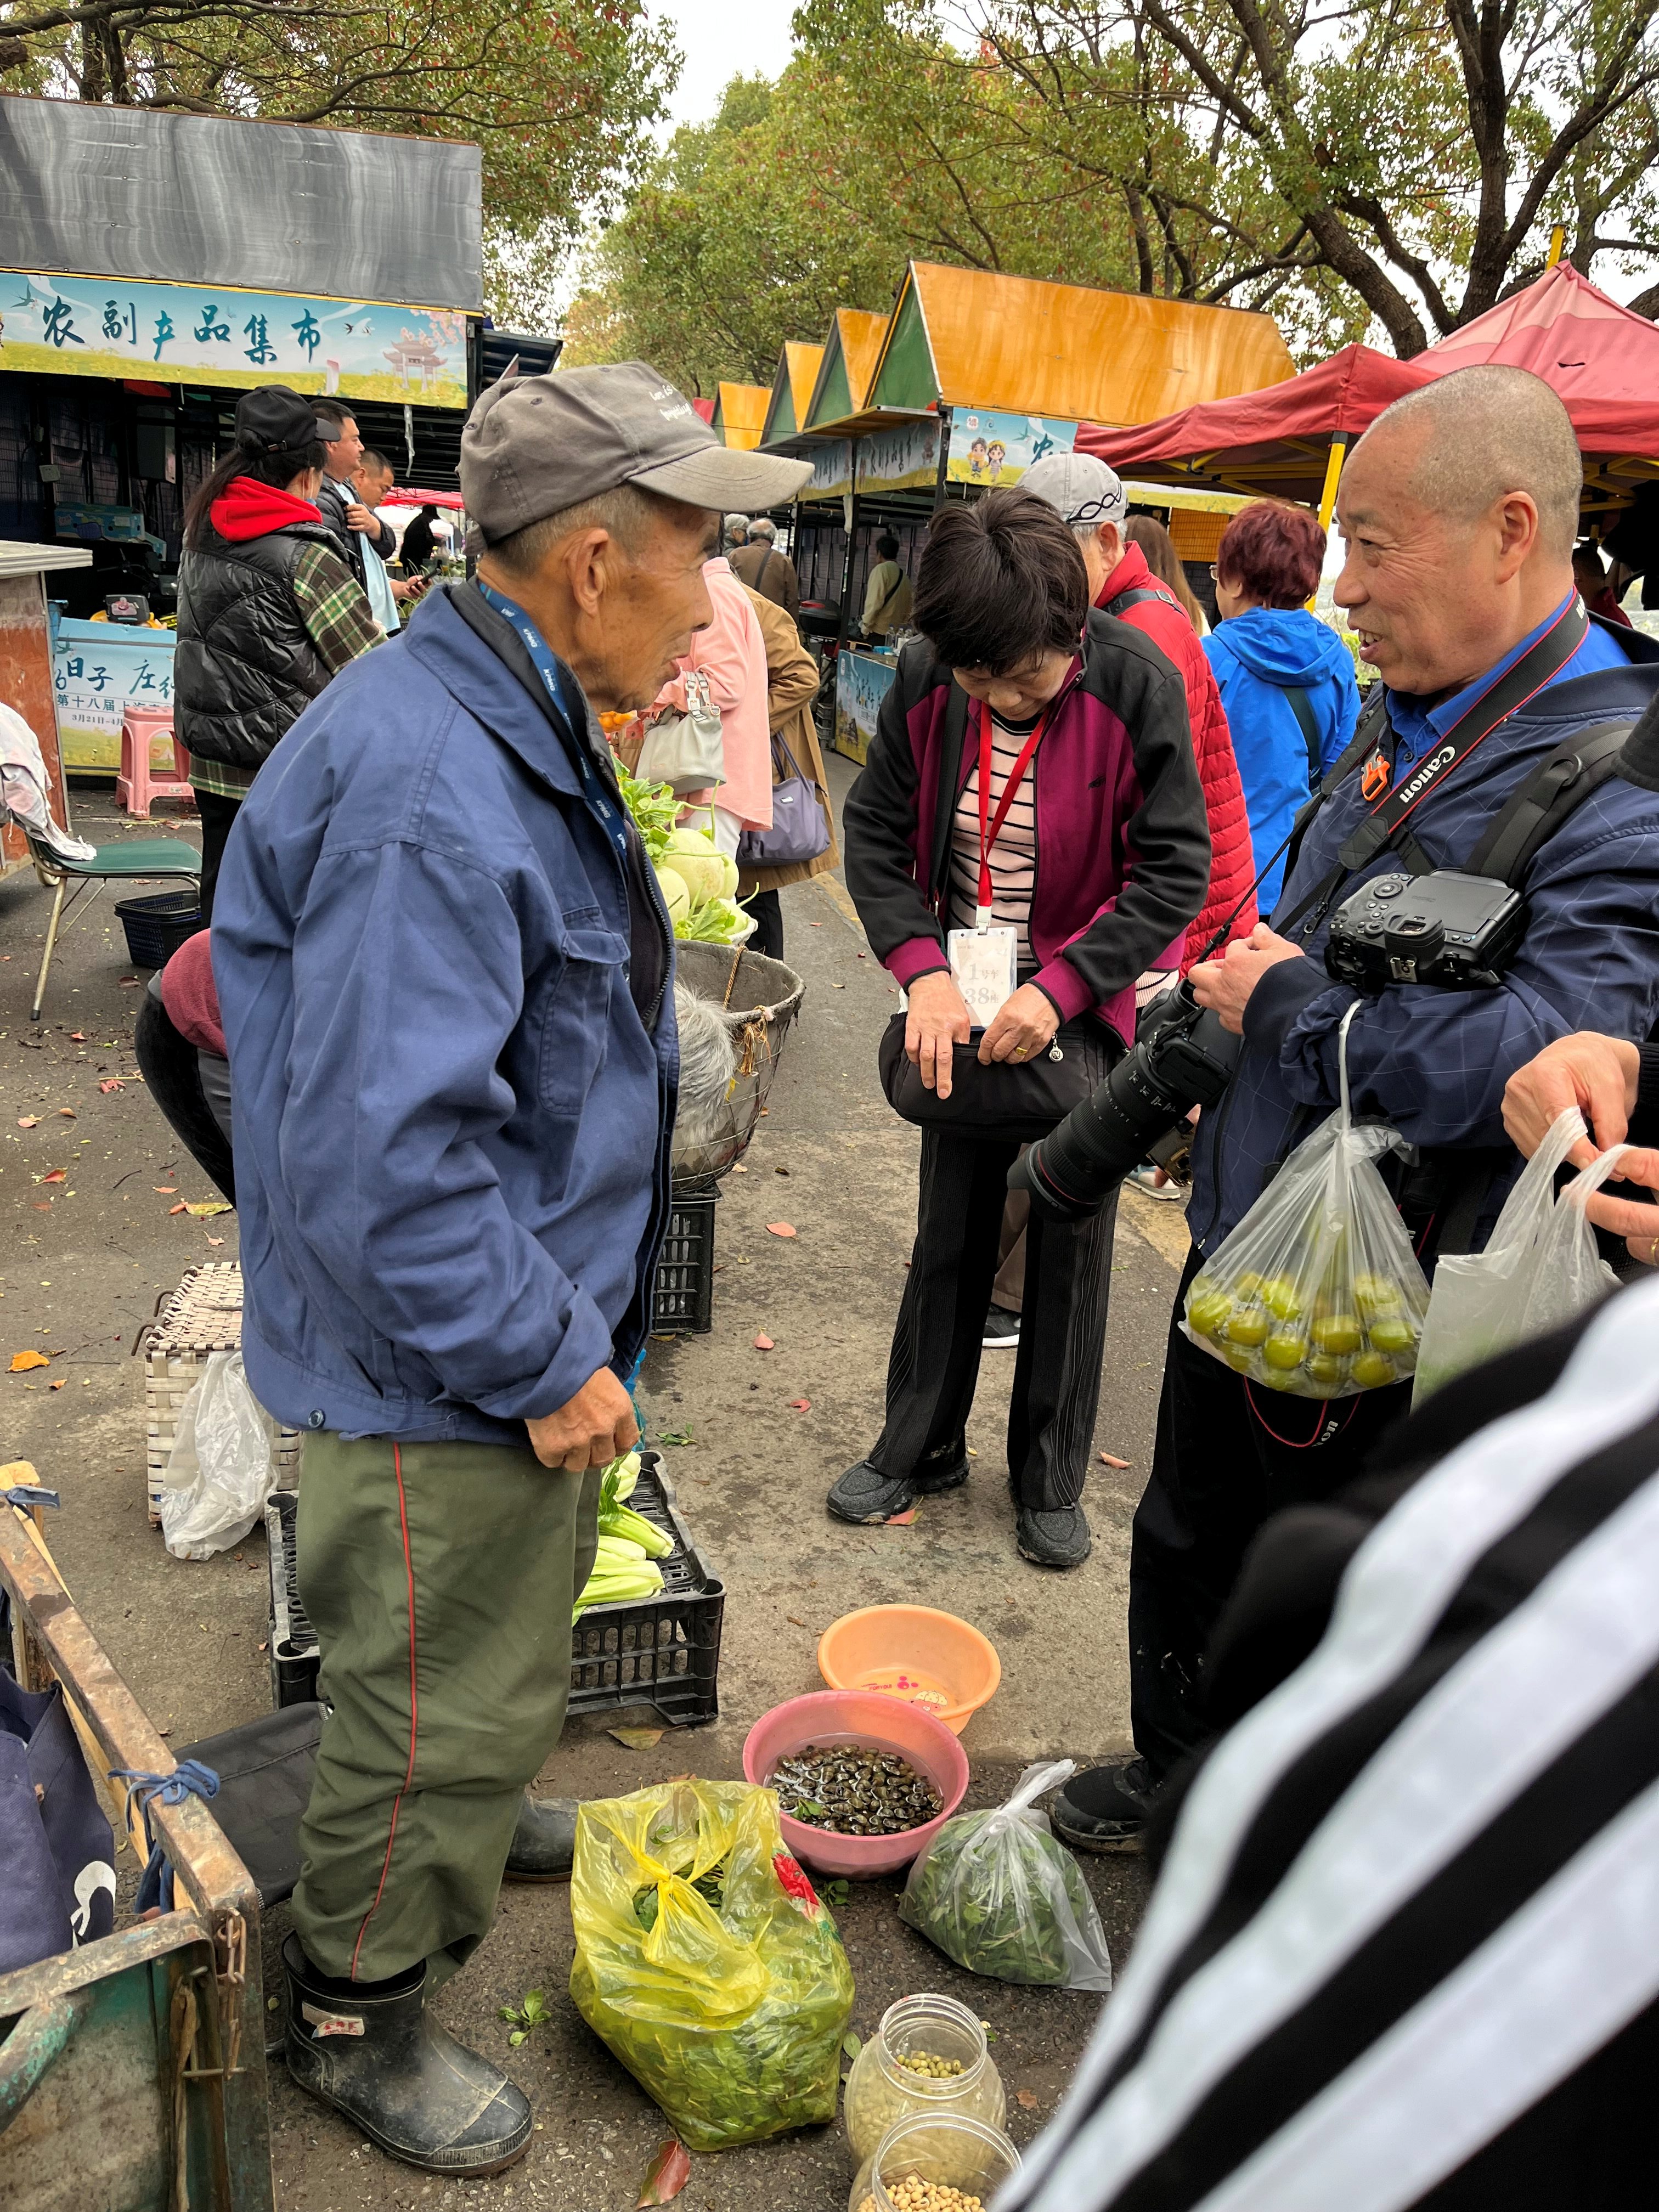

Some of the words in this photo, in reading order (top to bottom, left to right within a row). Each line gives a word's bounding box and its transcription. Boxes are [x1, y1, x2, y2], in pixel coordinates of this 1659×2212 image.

[42, 295, 321, 364] 农副产品集市
[522, 628, 538, 648] KPMG
[543, 668, 556, 691] KPMG
[1399, 746, 1456, 803] Canon
[595, 800, 611, 819] KPMG
[964, 987, 999, 1005] 38座
